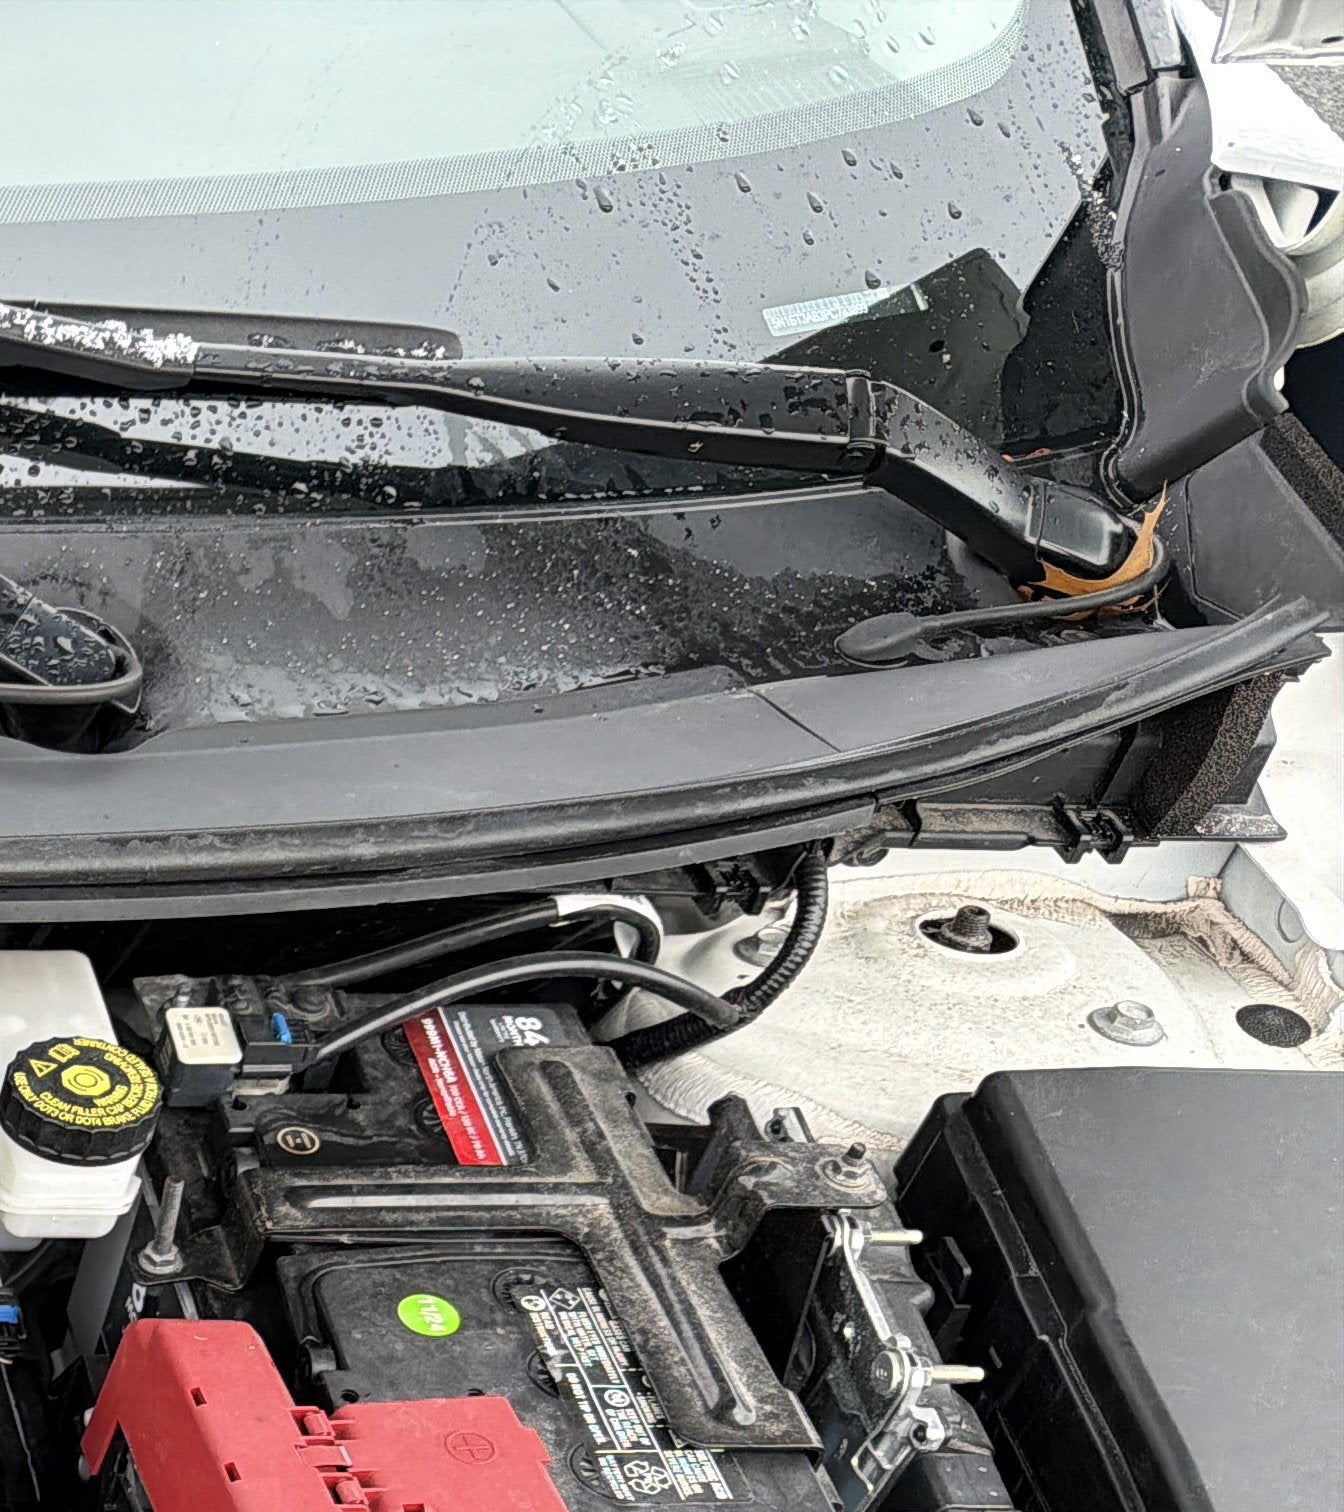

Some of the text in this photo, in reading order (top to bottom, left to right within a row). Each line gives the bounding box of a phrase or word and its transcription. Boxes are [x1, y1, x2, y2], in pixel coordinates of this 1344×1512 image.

[502, 1015, 524, 1046] MONTH
[514, 1016, 550, 1046] 84
[74, 1038, 127, 1056] CONTAINER
[125, 1054, 153, 1077] SEALED
[34, 1100, 59, 1117] DOT3
[40, 1092, 71, 1111] CLEAN
[71, 1106, 106, 1116] FILLER
[58, 1111, 74, 1122] OR
[75, 1116, 101, 1126] DOT4
[102, 1112, 135, 1125] BRAKE
[416, 1297, 448, 1332] 11/24
[566, 1373, 579, 1383] DO
[571, 1383, 586, 1399] NOT
[578, 1400, 591, 1412] TIP
[583, 1413, 596, 1424] OR
